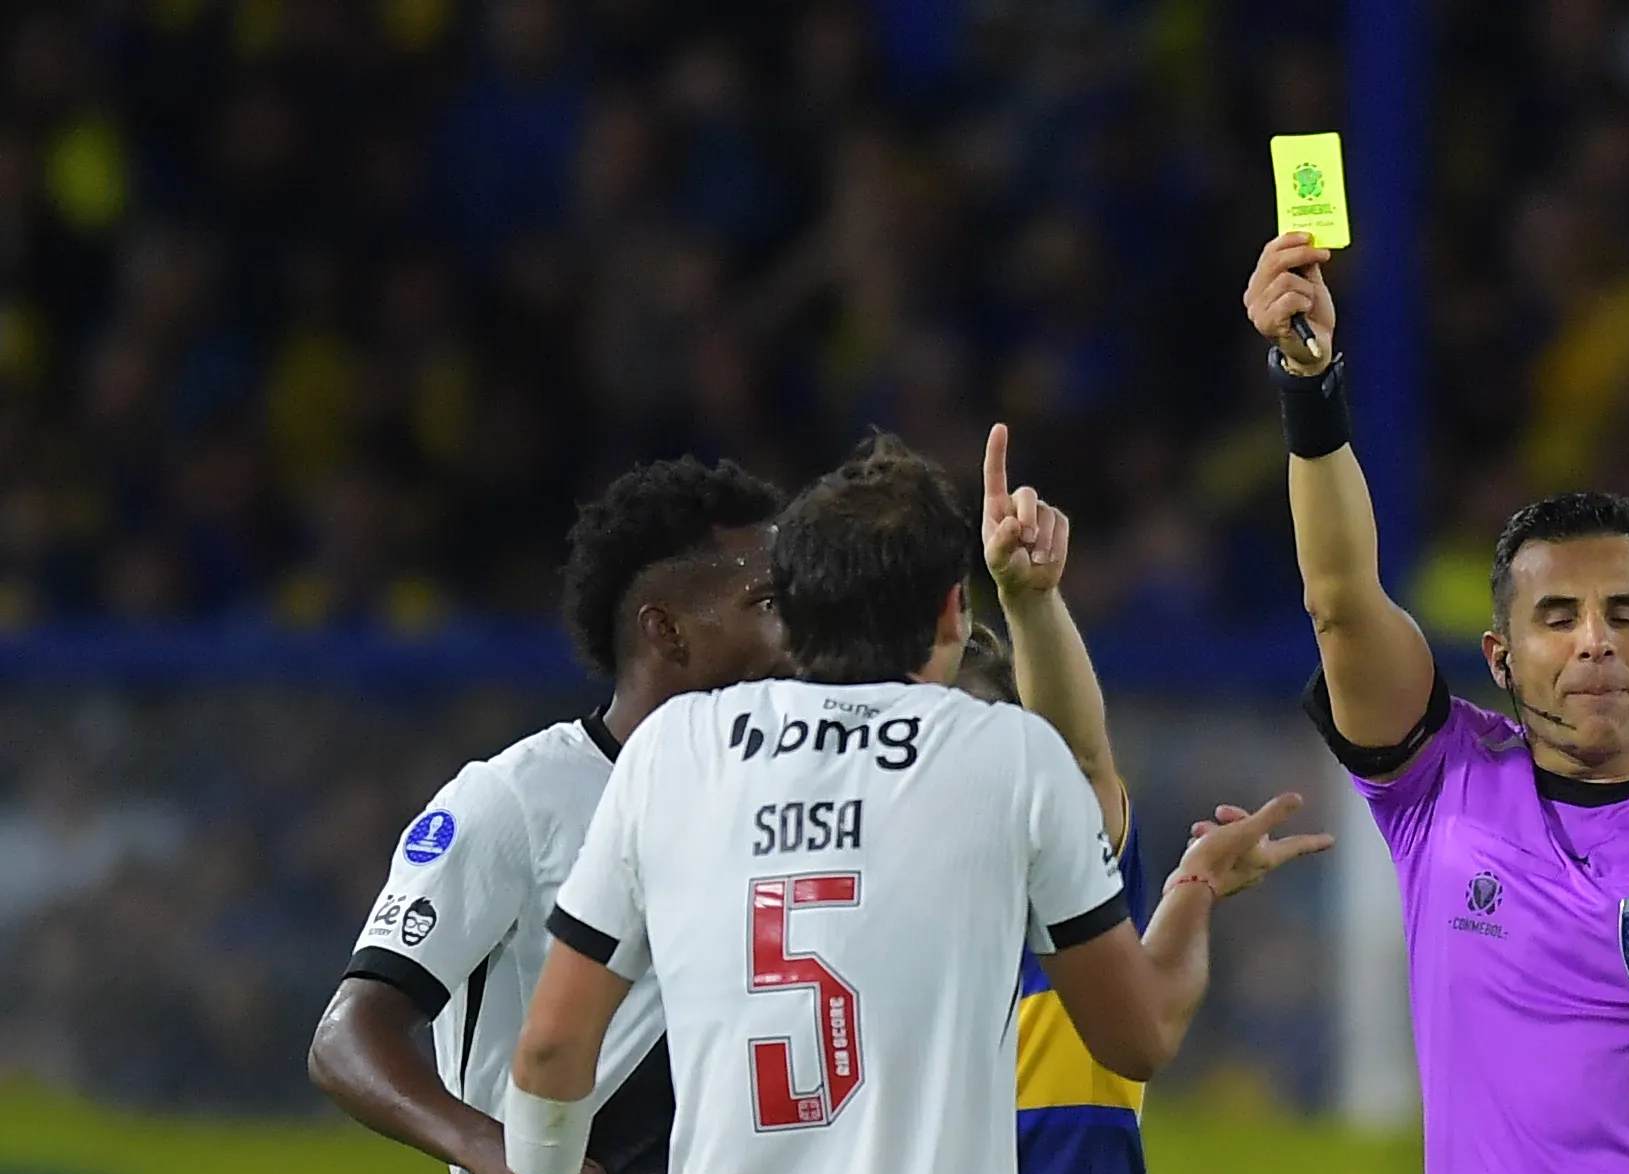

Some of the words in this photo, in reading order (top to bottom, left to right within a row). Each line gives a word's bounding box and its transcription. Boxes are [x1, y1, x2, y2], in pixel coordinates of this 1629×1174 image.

[773, 714, 921, 770] bmg
[753, 800, 862, 856] SOSA
[747, 870, 866, 1133] 5
